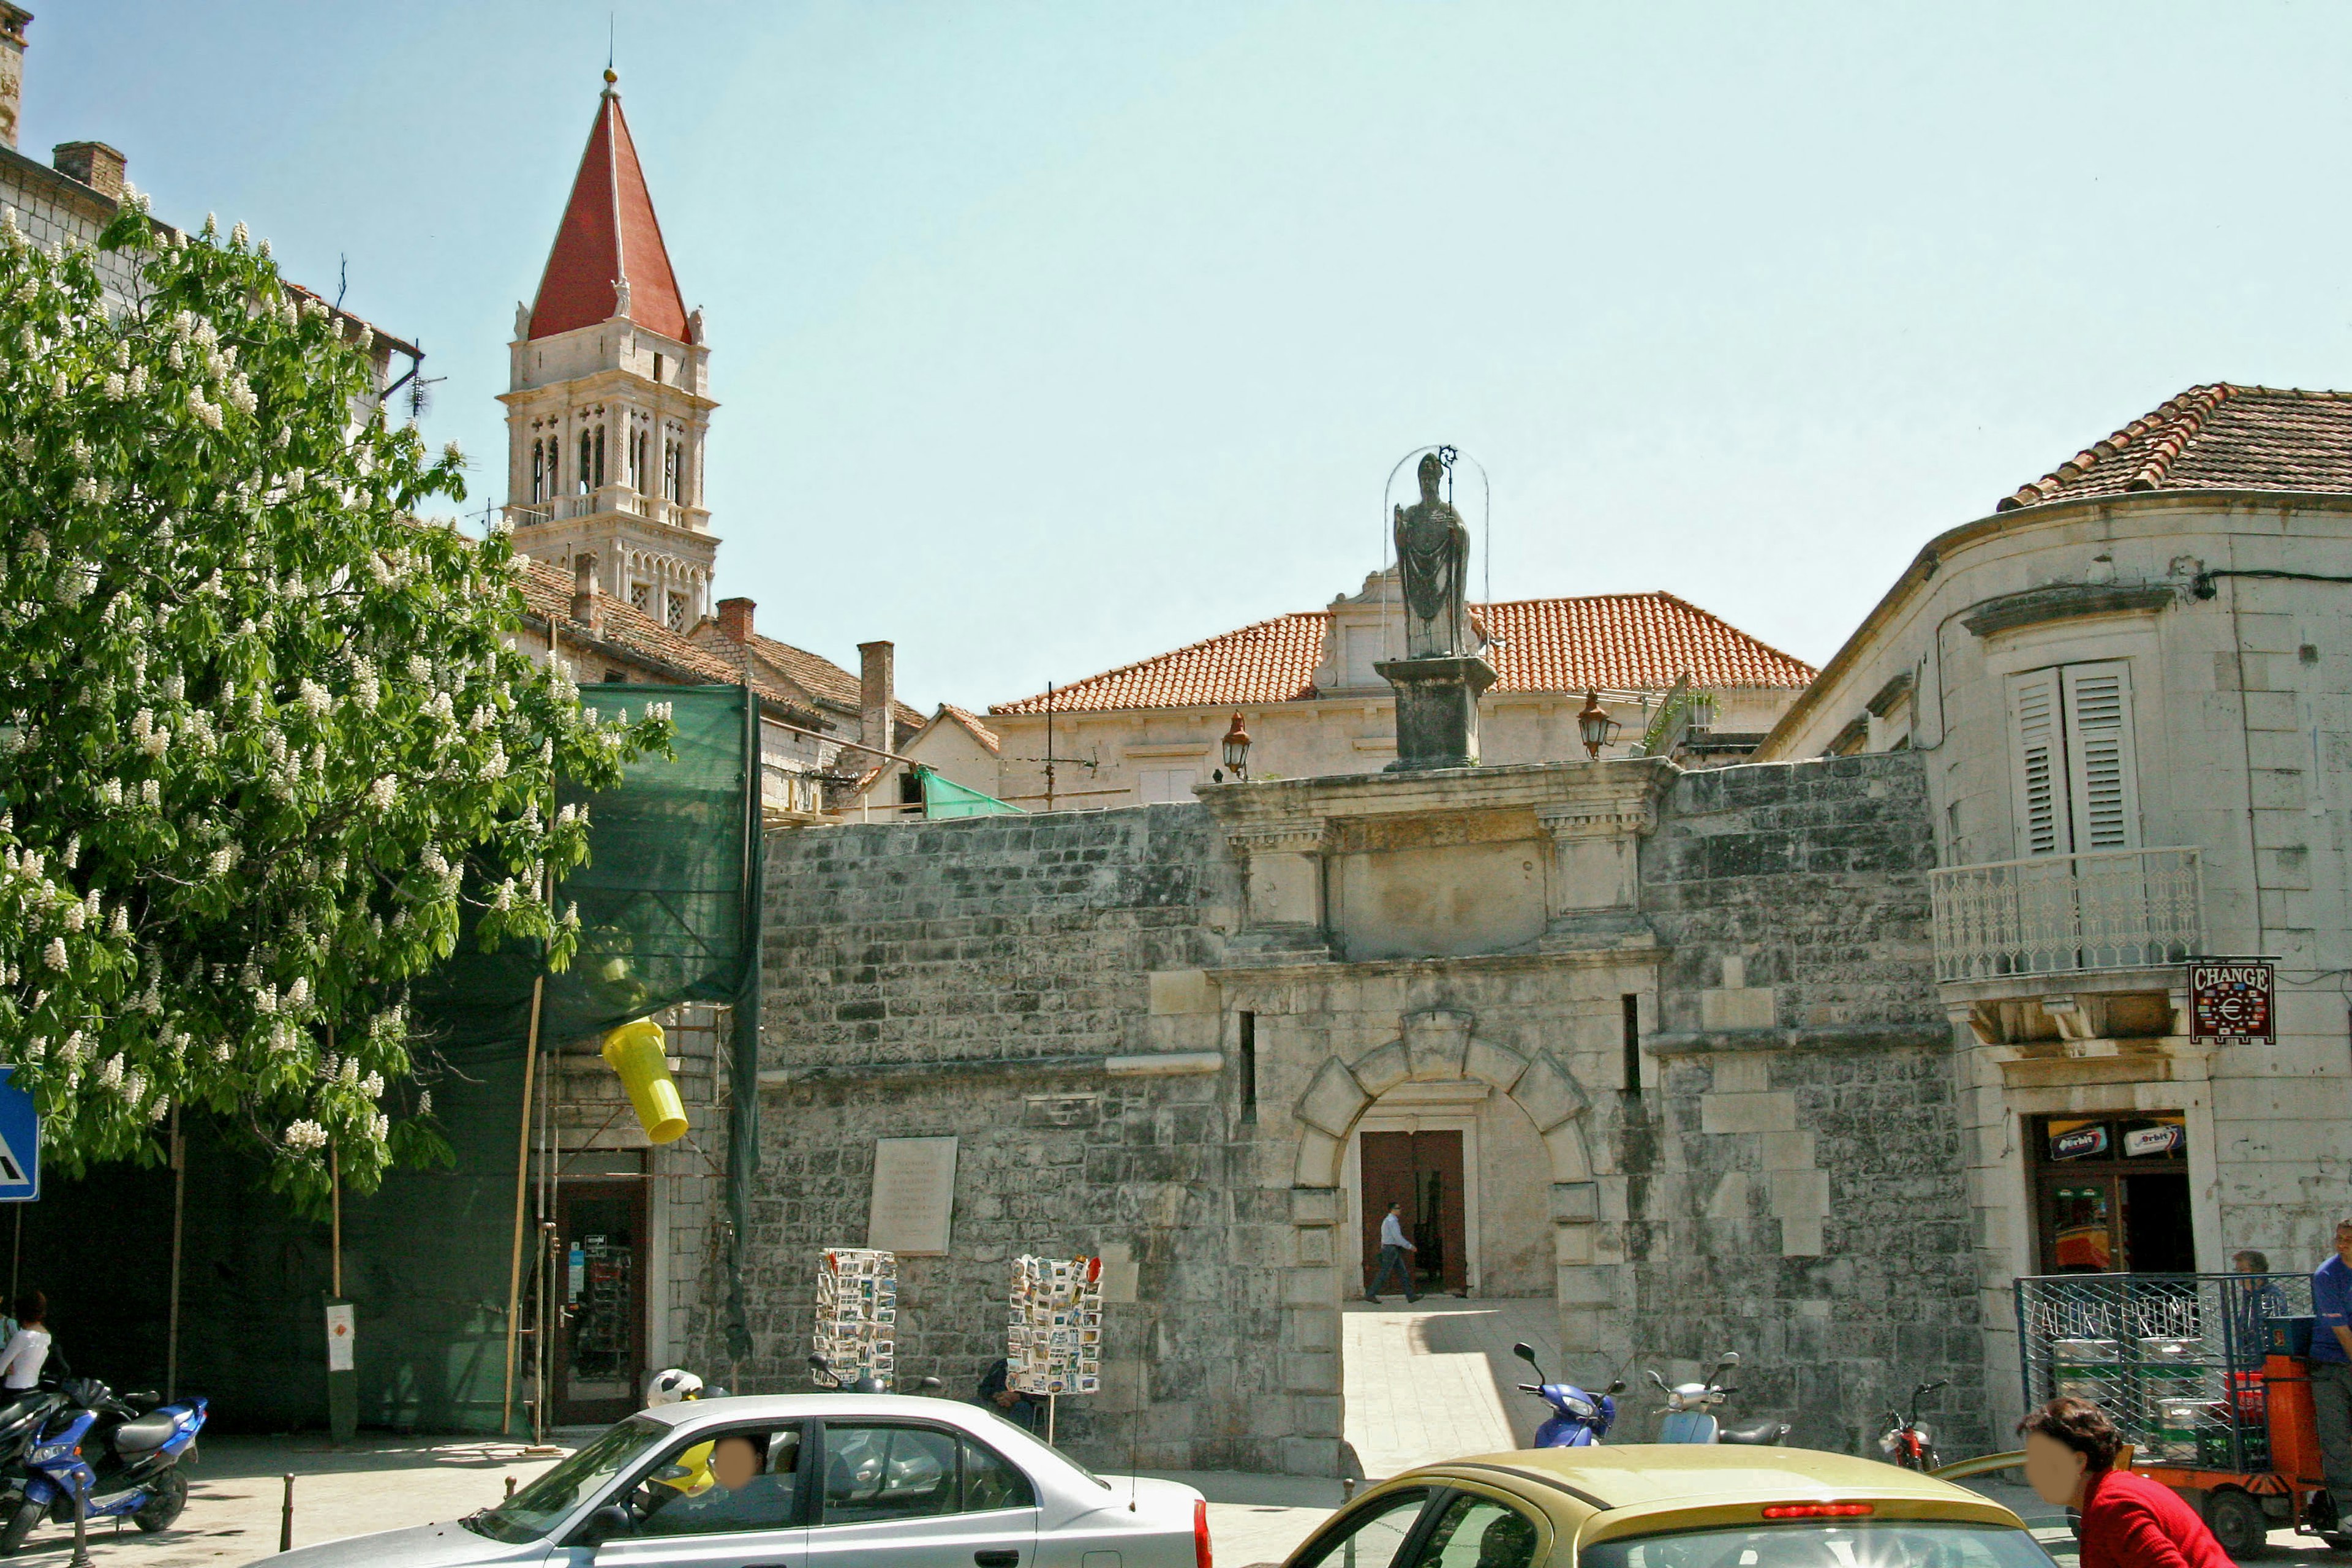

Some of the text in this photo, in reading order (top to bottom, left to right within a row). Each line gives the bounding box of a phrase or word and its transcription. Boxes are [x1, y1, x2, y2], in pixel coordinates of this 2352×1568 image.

[2195, 968, 2269, 993] CHANGE
[2067, 1136, 2093, 1147] Orbit
[2141, 1133, 2168, 1142] Orbit
